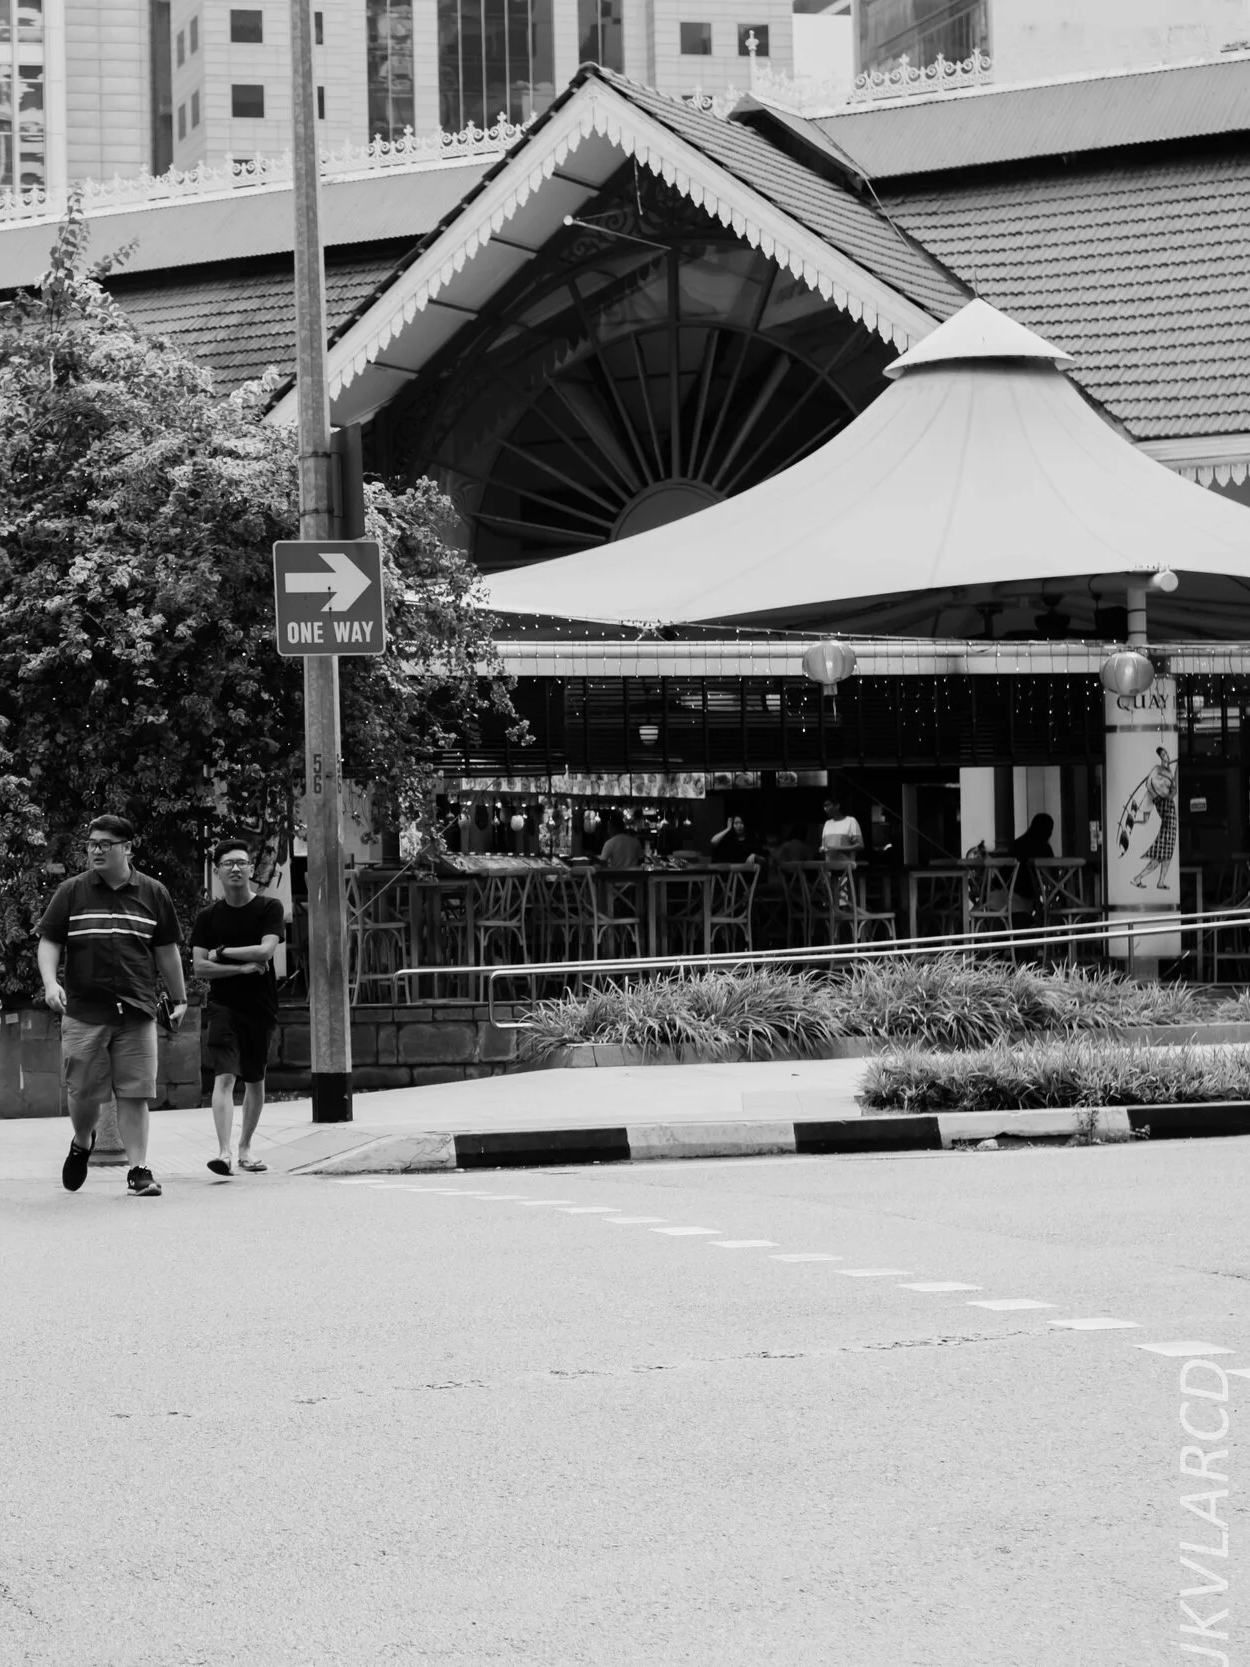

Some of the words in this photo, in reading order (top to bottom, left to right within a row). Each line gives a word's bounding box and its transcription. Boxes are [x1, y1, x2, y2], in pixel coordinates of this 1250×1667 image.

[287, 621, 324, 644] ONE
[334, 621, 374, 643] WAY
[1117, 694, 1168, 711] QUAY
